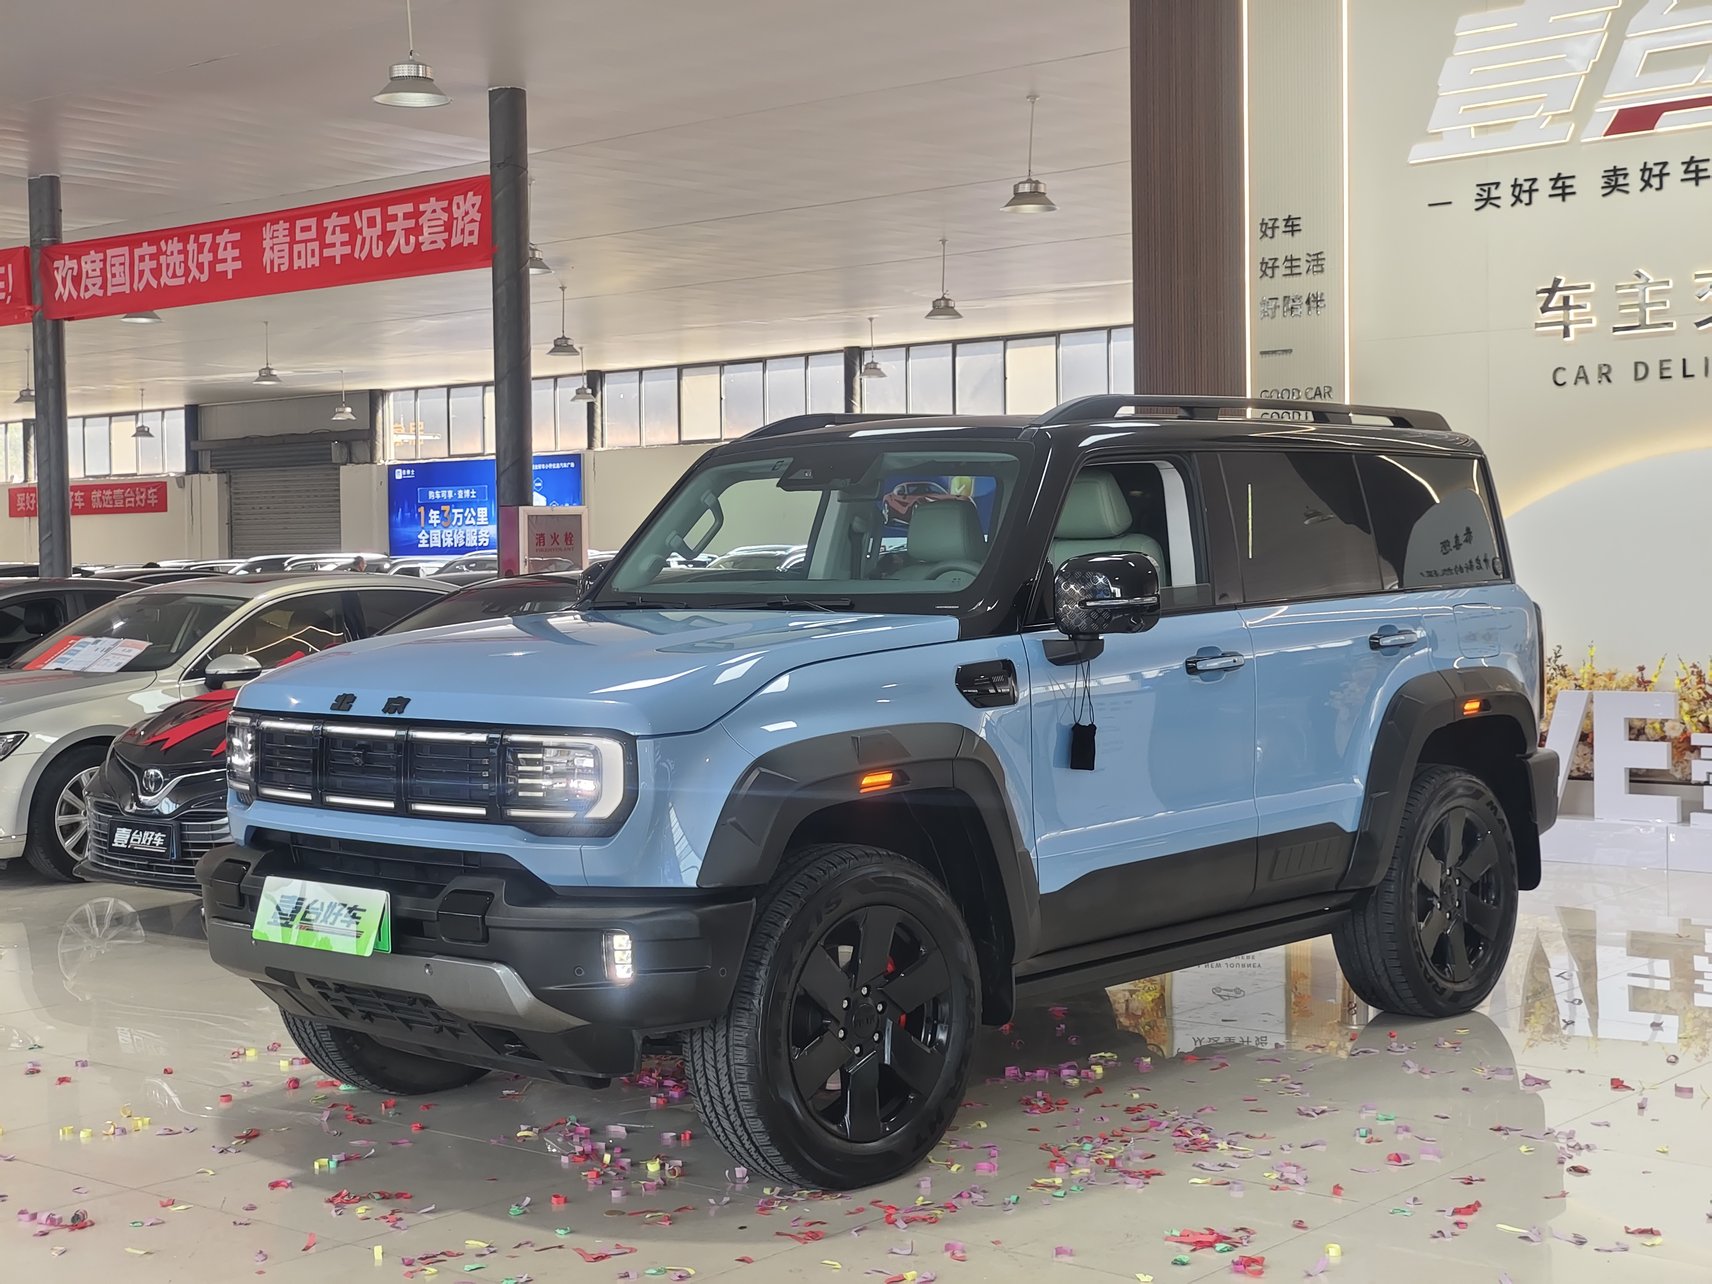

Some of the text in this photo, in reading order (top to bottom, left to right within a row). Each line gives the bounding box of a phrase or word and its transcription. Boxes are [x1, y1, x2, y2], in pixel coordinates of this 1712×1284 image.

[1474, 155, 1712, 211] 买好车 卖好车
[1259, 214, 1303, 240] 好车
[53, 190, 483, 303] 欢度国庆选好车 精品车况无套路
[1259, 250, 1326, 280] 好生活
[1259, 290, 1327, 320] 好陪伴
[1534, 269, 1712, 341] 车主
[1552, 362, 1613, 387] CAR
[1260, 385, 1334, 400] GOOD CAR
[91, 488, 158, 508] 就选壹台好车
[417, 529, 490, 548] 全国保修服务
[535, 531, 574, 547] 消火栓
[112, 827, 167, 849] 壹台好车
[267, 894, 367, 930] 壹台好车
